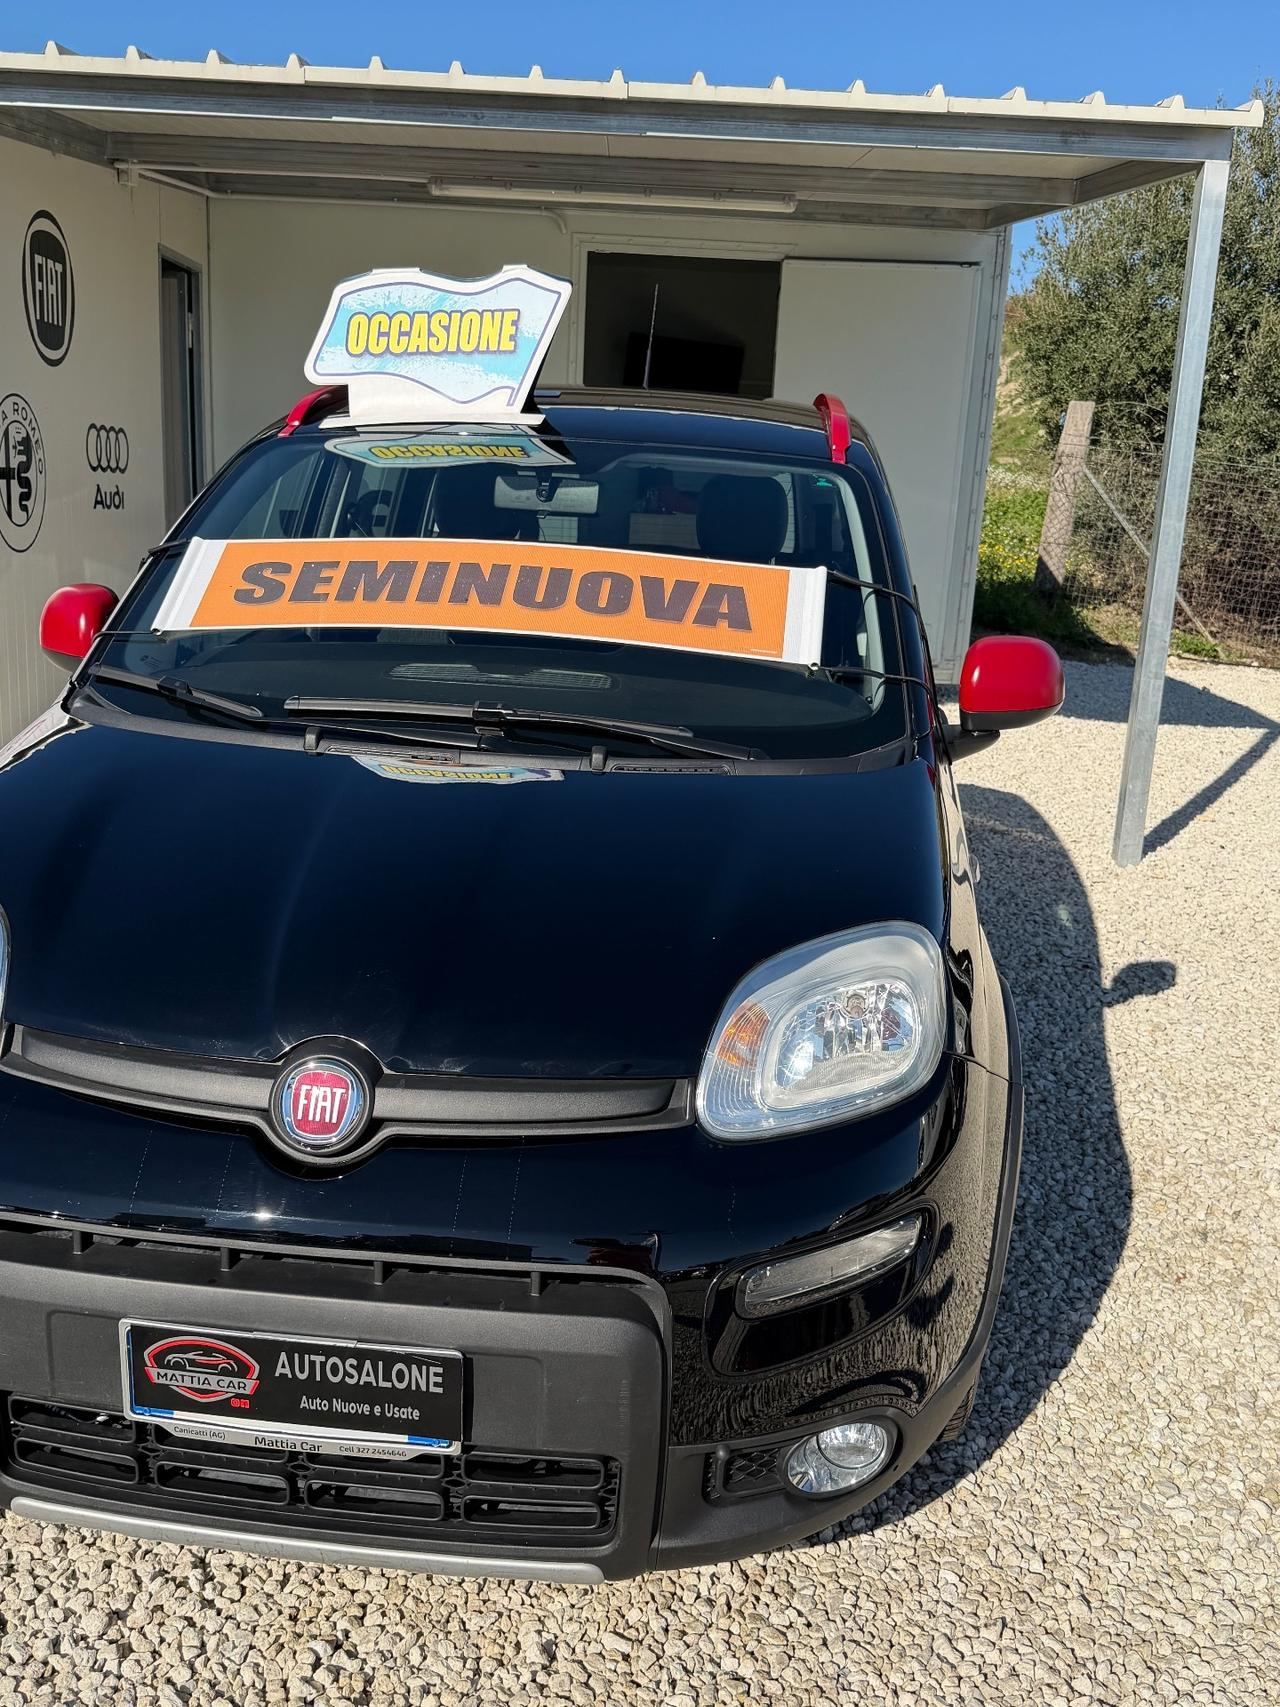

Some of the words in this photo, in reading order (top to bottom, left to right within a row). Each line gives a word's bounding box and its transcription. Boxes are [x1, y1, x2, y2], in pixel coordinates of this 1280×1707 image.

[34, 254, 63, 327] FIAT
[347, 309, 519, 356] OCCASIONE
[12, 402, 43, 475] ROMEO
[93, 484, 125, 510] Audi
[233, 560, 752, 632] SEMINUOVA
[297, 1084, 346, 1124] FIAT
[156, 1371, 212, 1387] MATTIA
[216, 1379, 247, 1391] CAR
[274, 1351, 444, 1394] AUTOSALONE
[300, 1395, 329, 1411] Auto
[332, 1398, 371, 1415] Nuove
[373, 1405, 382, 1416] e
[385, 1403, 420, 1420] Usate
[208, 1430, 226, 1441] (AG)
[254, 1436, 297, 1450] Mattia
[300, 1441, 323, 1452] Car
[339, 1445, 355, 1453] Cell
